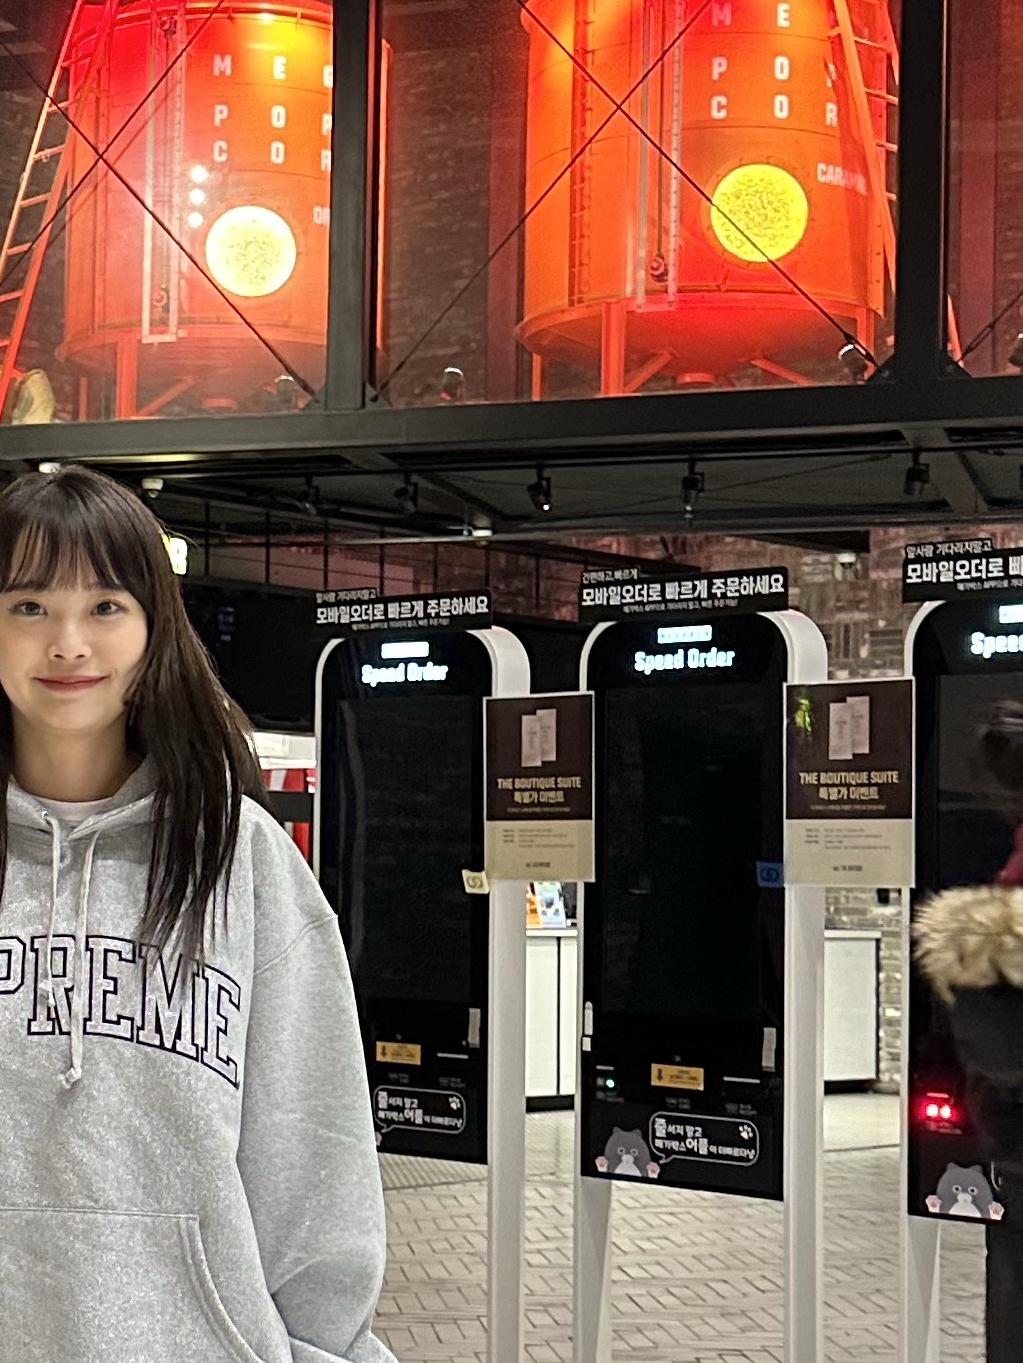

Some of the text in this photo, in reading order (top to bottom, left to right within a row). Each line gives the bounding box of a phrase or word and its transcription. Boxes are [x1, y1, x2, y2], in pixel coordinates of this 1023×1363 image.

[906, 557, 1004, 583] 모바일오더로
[582, 574, 785, 606] 모바일오더로 빠르게 주문하세요
[316, 596, 489, 624] 모바일오더로 빠르게 주문하세요
[970, 632, 1023, 659] Spee
[634, 647, 735, 675] Speed Order
[361, 662, 405, 687] Speed
[497, 776, 581, 790] THE BOUTIQUE SUITE
[799, 770, 900, 786] THE BOUTIQUE SUITE
[849, 786, 879, 801] 이벤트
